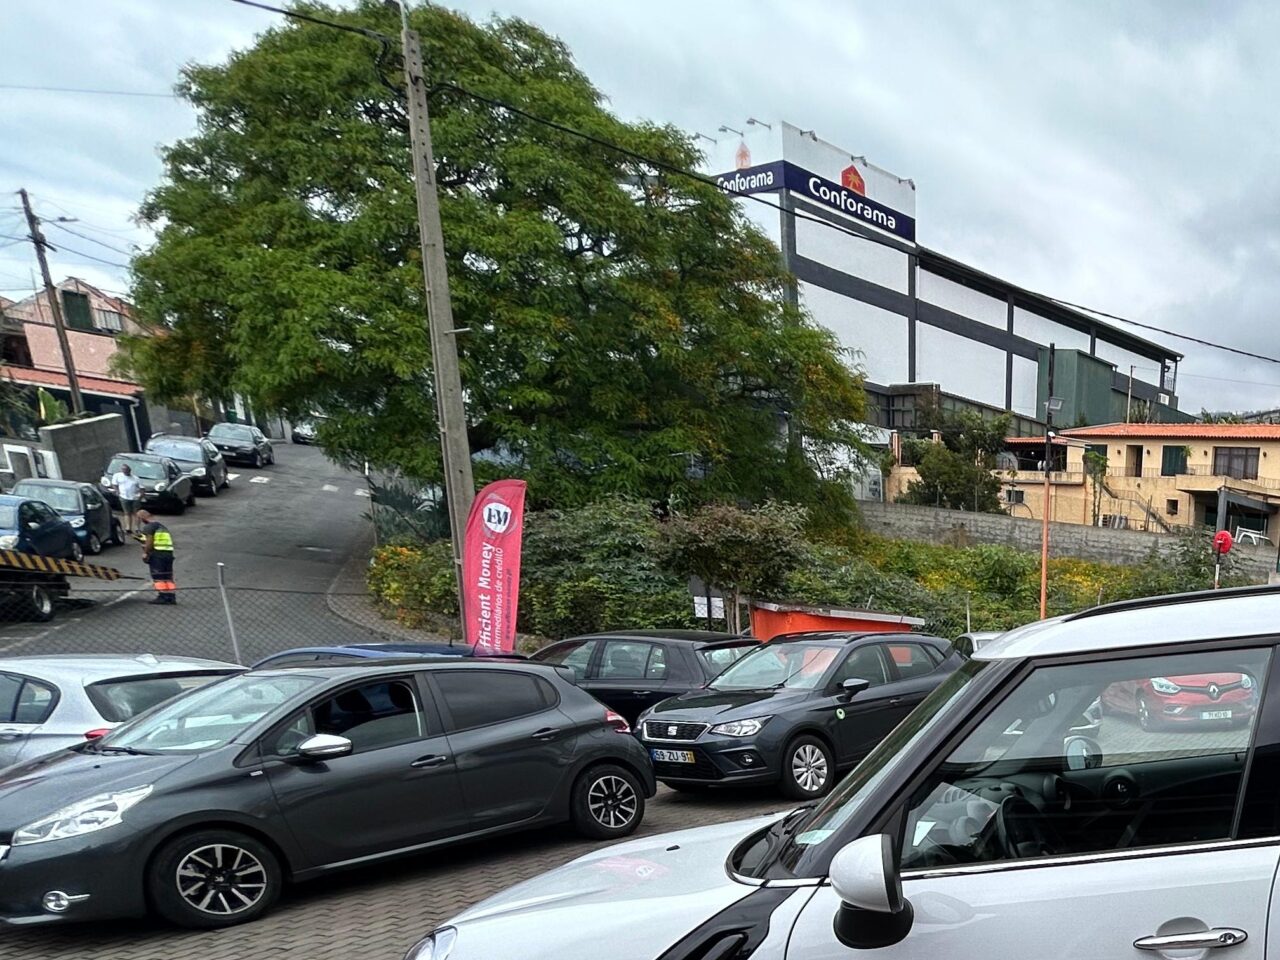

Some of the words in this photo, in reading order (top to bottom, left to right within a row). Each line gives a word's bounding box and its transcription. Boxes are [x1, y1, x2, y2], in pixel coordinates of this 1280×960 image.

[808, 177, 896, 230] Conforama
[478, 541, 495, 589] Money
[495, 580, 503, 592] de
[478, 594, 491, 647] fficient
